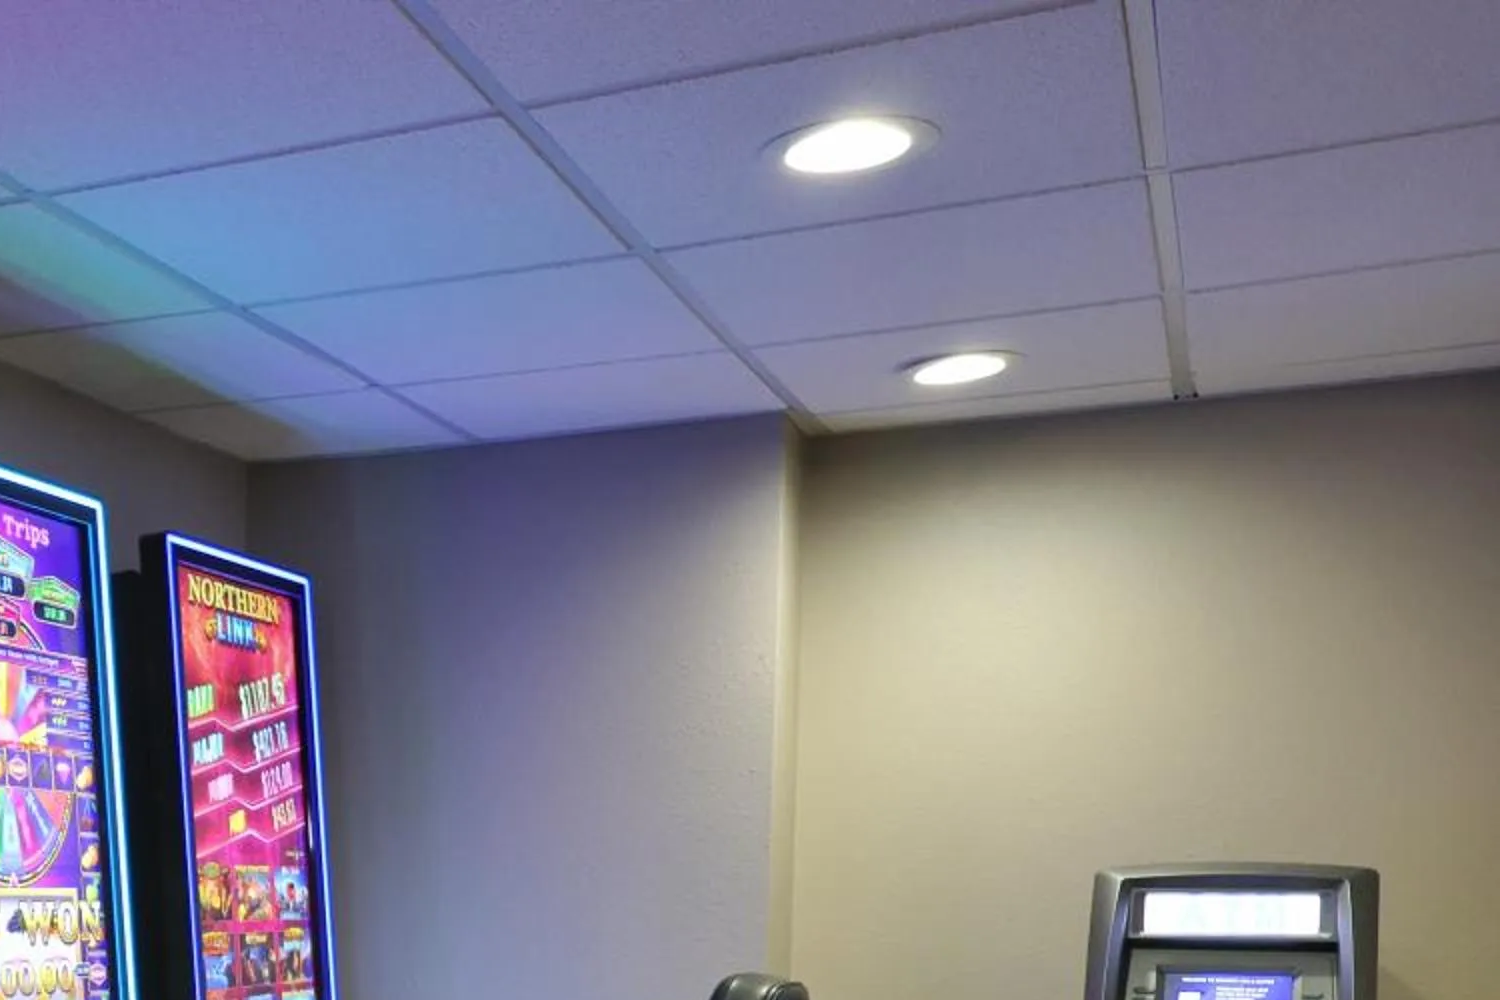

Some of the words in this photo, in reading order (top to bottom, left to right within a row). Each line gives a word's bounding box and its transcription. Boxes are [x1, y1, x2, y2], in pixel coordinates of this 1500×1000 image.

[3, 513, 50, 549] Trips
[188, 574, 278, 624] NORTHERN
[20, 900, 104, 948] WON
